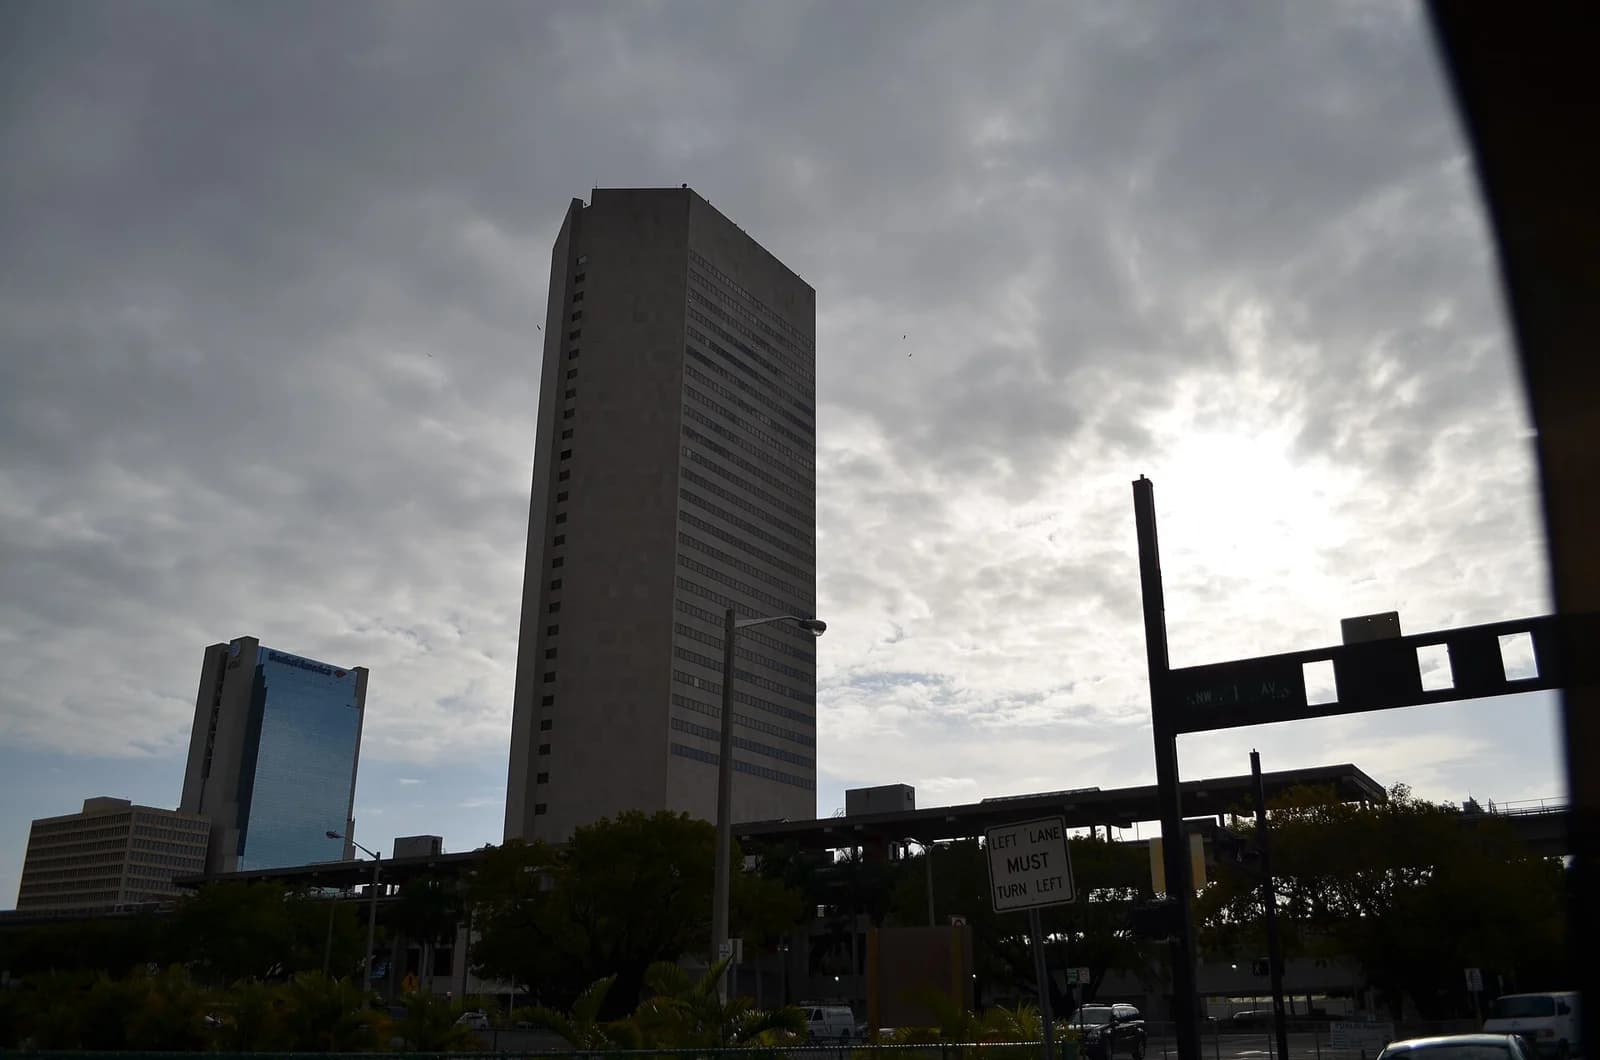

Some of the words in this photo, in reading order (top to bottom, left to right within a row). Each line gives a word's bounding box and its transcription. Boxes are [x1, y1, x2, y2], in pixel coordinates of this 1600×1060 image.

[992, 834, 1016, 850] LEFT
[1030, 827, 1061, 844] LANE
[1007, 853, 1049, 873] MUST
[997, 882, 1027, 899] TURN
[1036, 876, 1063, 892] LEFT
